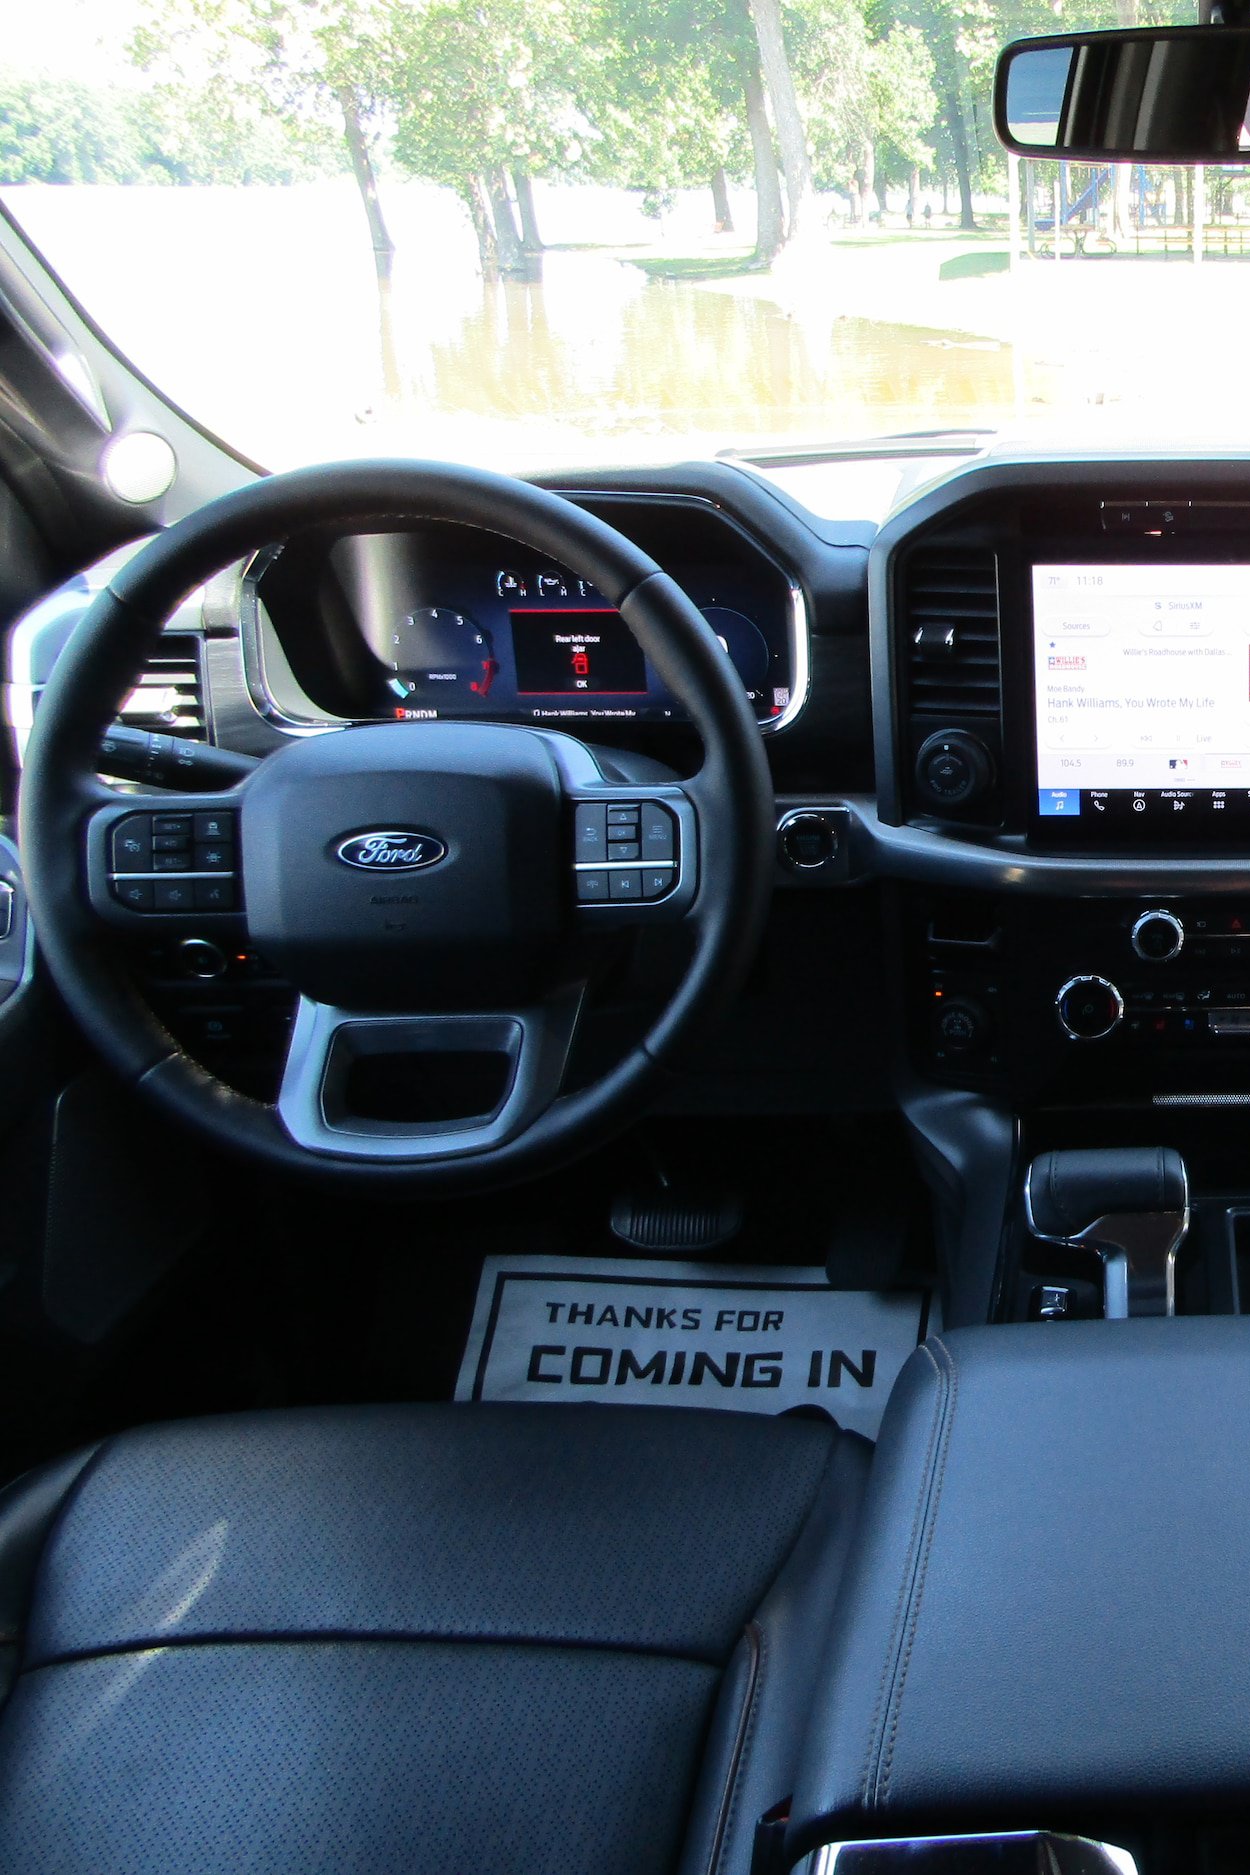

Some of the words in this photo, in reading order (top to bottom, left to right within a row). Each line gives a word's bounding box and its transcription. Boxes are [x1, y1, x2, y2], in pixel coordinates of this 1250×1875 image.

[1077, 576, 1103, 586] 11:18
[1168, 601, 1203, 610] SiriusXM
[432, 610, 438, 619] 4
[408, 617, 415, 626] 3
[457, 617, 464, 626] 5
[1062, 622, 1090, 631] Sources
[476, 635, 483, 644] 6
[555, 634, 571, 643] Rear
[572, 634, 584, 643] left
[584, 634, 601, 643] door
[572, 644, 586, 653] ajar
[1123, 648, 1149, 656] Willie's
[1149, 648, 1186, 656] Roadhouse
[1187, 648, 1203, 656] with
[1204, 648, 1225, 656] Dallas
[409, 682, 416, 691] 0
[576, 680, 587, 688] OK
[1047, 685, 1062, 693] Moe
[1063, 685, 1085, 694] Bandy
[1047, 698, 1074, 709] Hank
[1077, 698, 1123, 710] Williams,
[1124, 698, 1144, 709] You
[1146, 698, 1177, 709] Wrote
[1179, 698, 1194, 711] My
[1196, 698, 1216, 709] Life
[1196, 735, 1212, 743] Live
[1060, 759, 1082, 768] 104.5
[1116, 759, 1134, 768] 89.9
[1211, 791, 1226, 799] Apps
[358, 837, 424, 864] Ford
[545, 1301, 701, 1331] THANKS
[714, 1310, 785, 1332] FOR
[526, 1344, 784, 1389] COMING
[806, 1350, 877, 1389] IN
